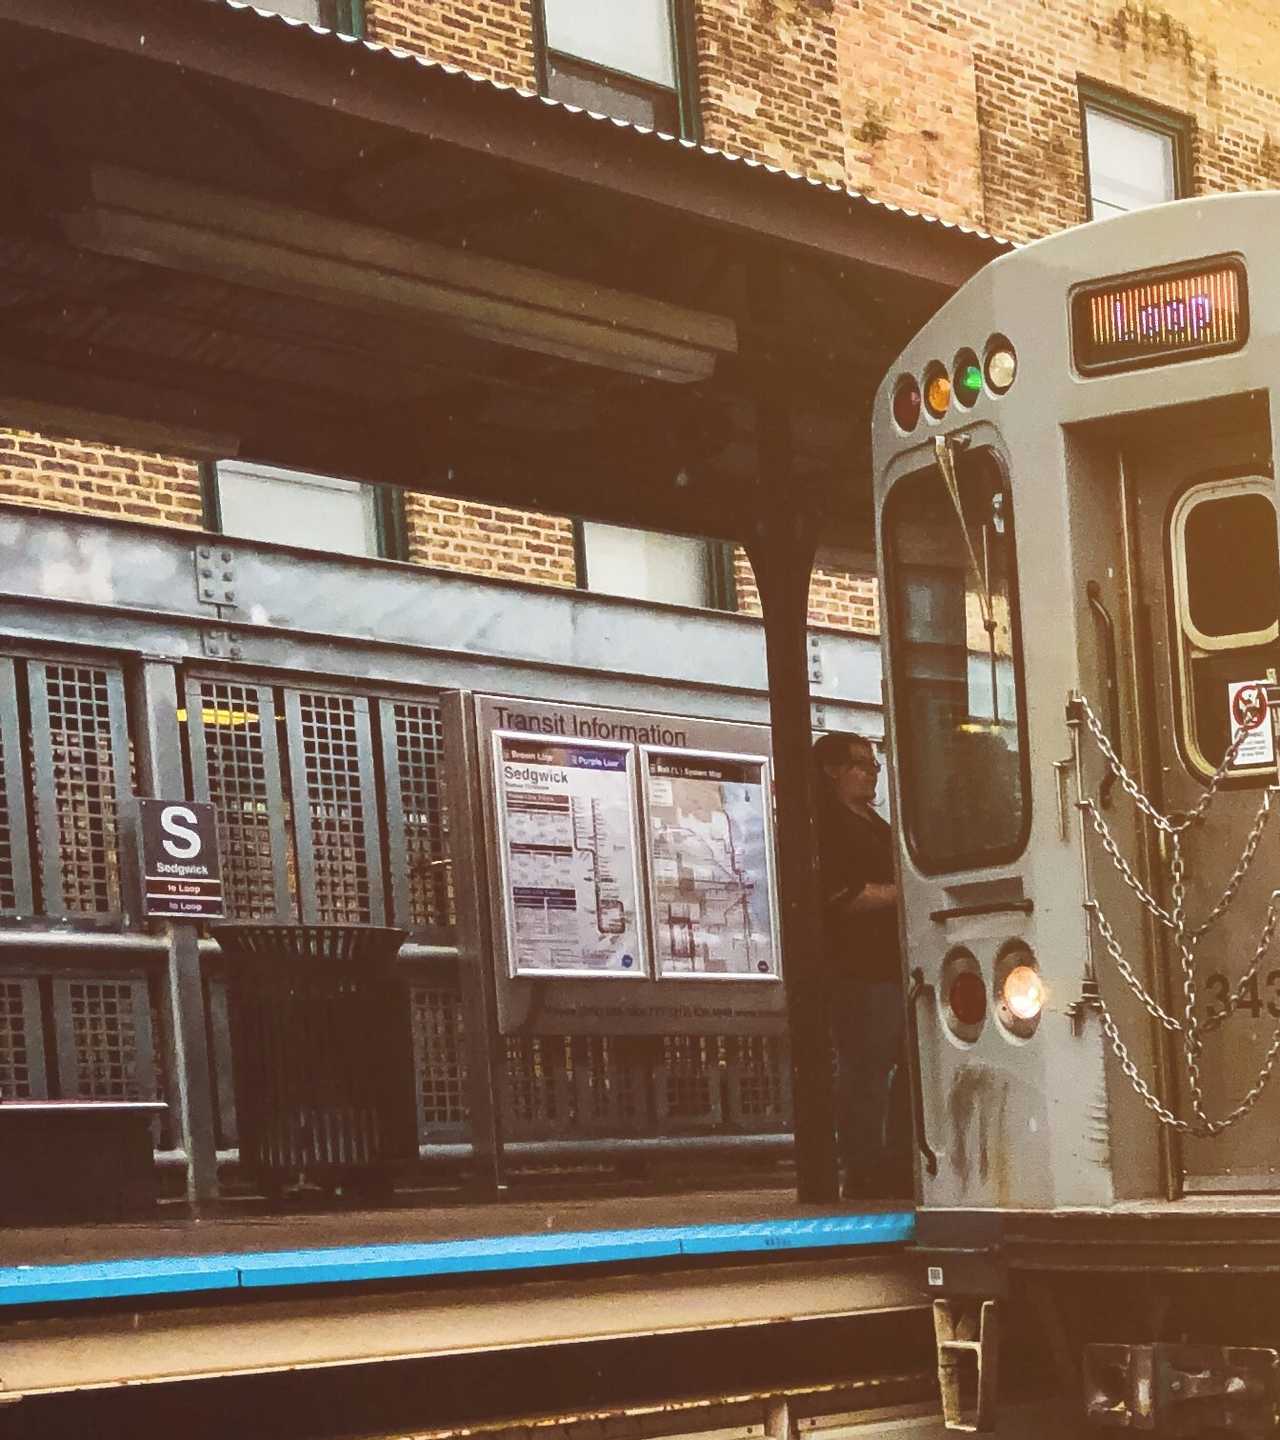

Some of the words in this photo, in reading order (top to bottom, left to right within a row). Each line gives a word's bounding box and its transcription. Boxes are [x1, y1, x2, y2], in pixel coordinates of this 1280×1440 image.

[1114, 296, 1211, 342] Loop
[493, 707, 567, 735] Transit
[572, 715, 688, 747] Information
[504, 765, 569, 784] Sedgwick
[160, 806, 202, 859] S
[157, 862, 208, 875] Sedgwick
[178, 884, 201, 894] Loop
[180, 902, 202, 911] Loop
